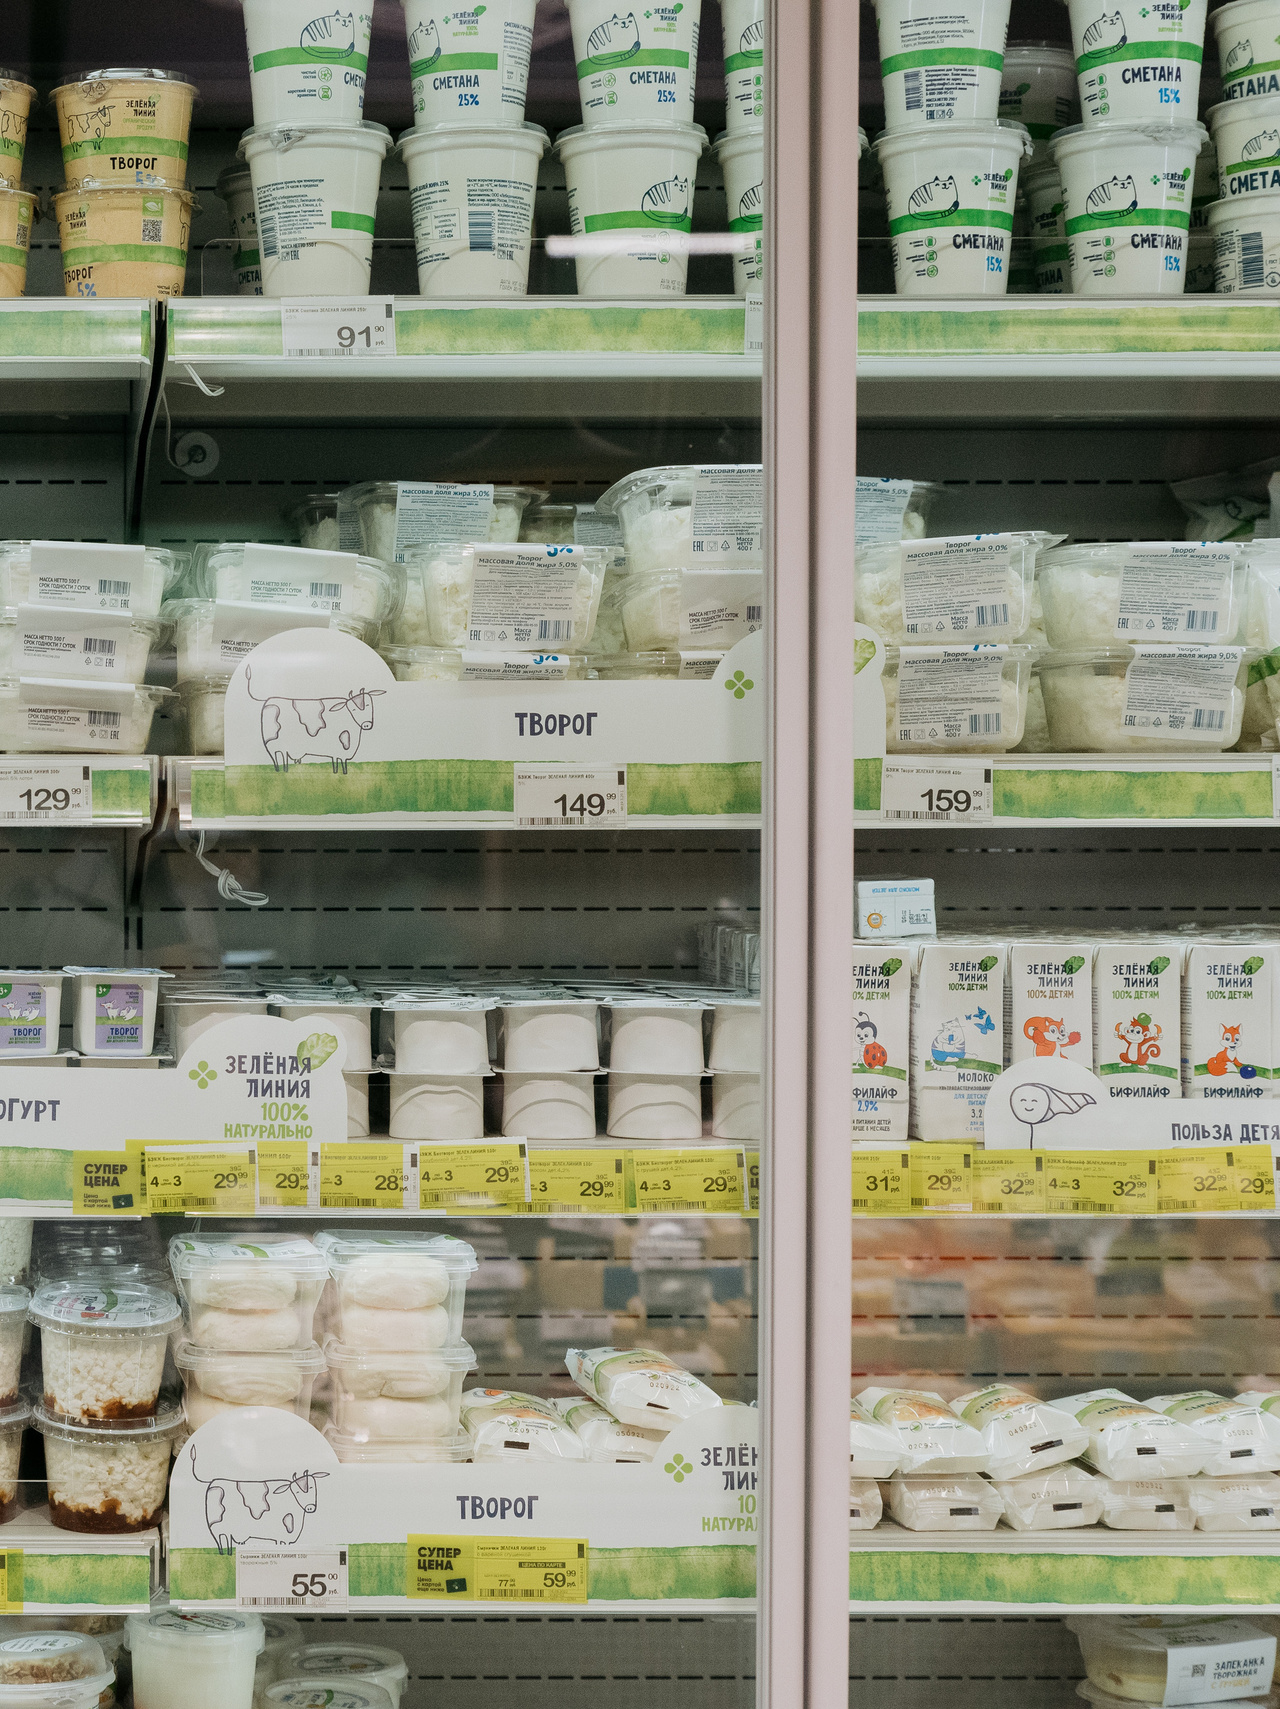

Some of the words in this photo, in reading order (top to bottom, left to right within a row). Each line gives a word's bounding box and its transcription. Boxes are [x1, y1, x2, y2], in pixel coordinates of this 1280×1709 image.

[432, 75, 479, 90] СМЕТАНА
[1122, 66, 1182, 84] СМЕТАНА
[458, 94, 479, 107] 25%
[657, 89, 676, 103] 25%
[1159, 88, 1180, 103] 15%
[110, 157, 157, 170] ТВОРОГ
[64, 266, 93, 283] ТВОРОГ
[77, 282, 96, 296] 5%
[337, 326, 371, 348] 91
[907, 551, 942, 559] массовая
[515, 713, 597, 736] ТВОРОГ
[20, 788, 70, 811] 129
[554, 793, 605, 817] 149
[920, 790, 971, 812] 159
[852, 964, 890, 977] ЕЛЁНАЯ
[958, 972, 988, 982] ЛИНИЯ
[98, 986, 107, 994] 3+
[1027, 989, 1047, 999] 100%
[1049, 989, 1074, 999] ДЕТЯМ
[225, 1052, 312, 1074] ЗЕЛЁНАЯ
[247, 1079, 310, 1099] ЛИНИЯ
[1110, 1086, 1170, 1098] БИФИЛАЙФ
[261, 1103, 308, 1121] 100%
[224, 1123, 313, 1139] НАТУРАЛЬНО
[1172, 1123, 1233, 1141] ПОЛЬЗА
[1240, 1124, 1280, 1143] ДЕТЯ
[84, 1164, 128, 1175] СУПЕР
[444, 1170, 453, 1181] 3
[485, 1167, 509, 1183] 29
[150, 1176, 159, 1187] 4
[173, 1175, 182, 1187] 3
[214, 1173, 238, 1189] 29
[374, 1175, 399, 1191] 28
[866, 1176, 890, 1192] 31
[1113, 1180, 1137, 1196] 32
[650, 1382, 680, 1391] 020922
[700, 1443, 758, 1466] ЗЕЛЁН
[456, 1495, 539, 1520] ТВОРОГ
[417, 1546, 462, 1561] СУПЕР
[417, 1560, 454, 1573] ЦЕНА
[291, 1574, 326, 1596] 55
[543, 1573, 566, 1587] 59
[1215, 1657, 1265, 1671] ЗАПЕКАНКА
[1213, 1669, 1258, 1679] ТВОРОЖНАЯ
